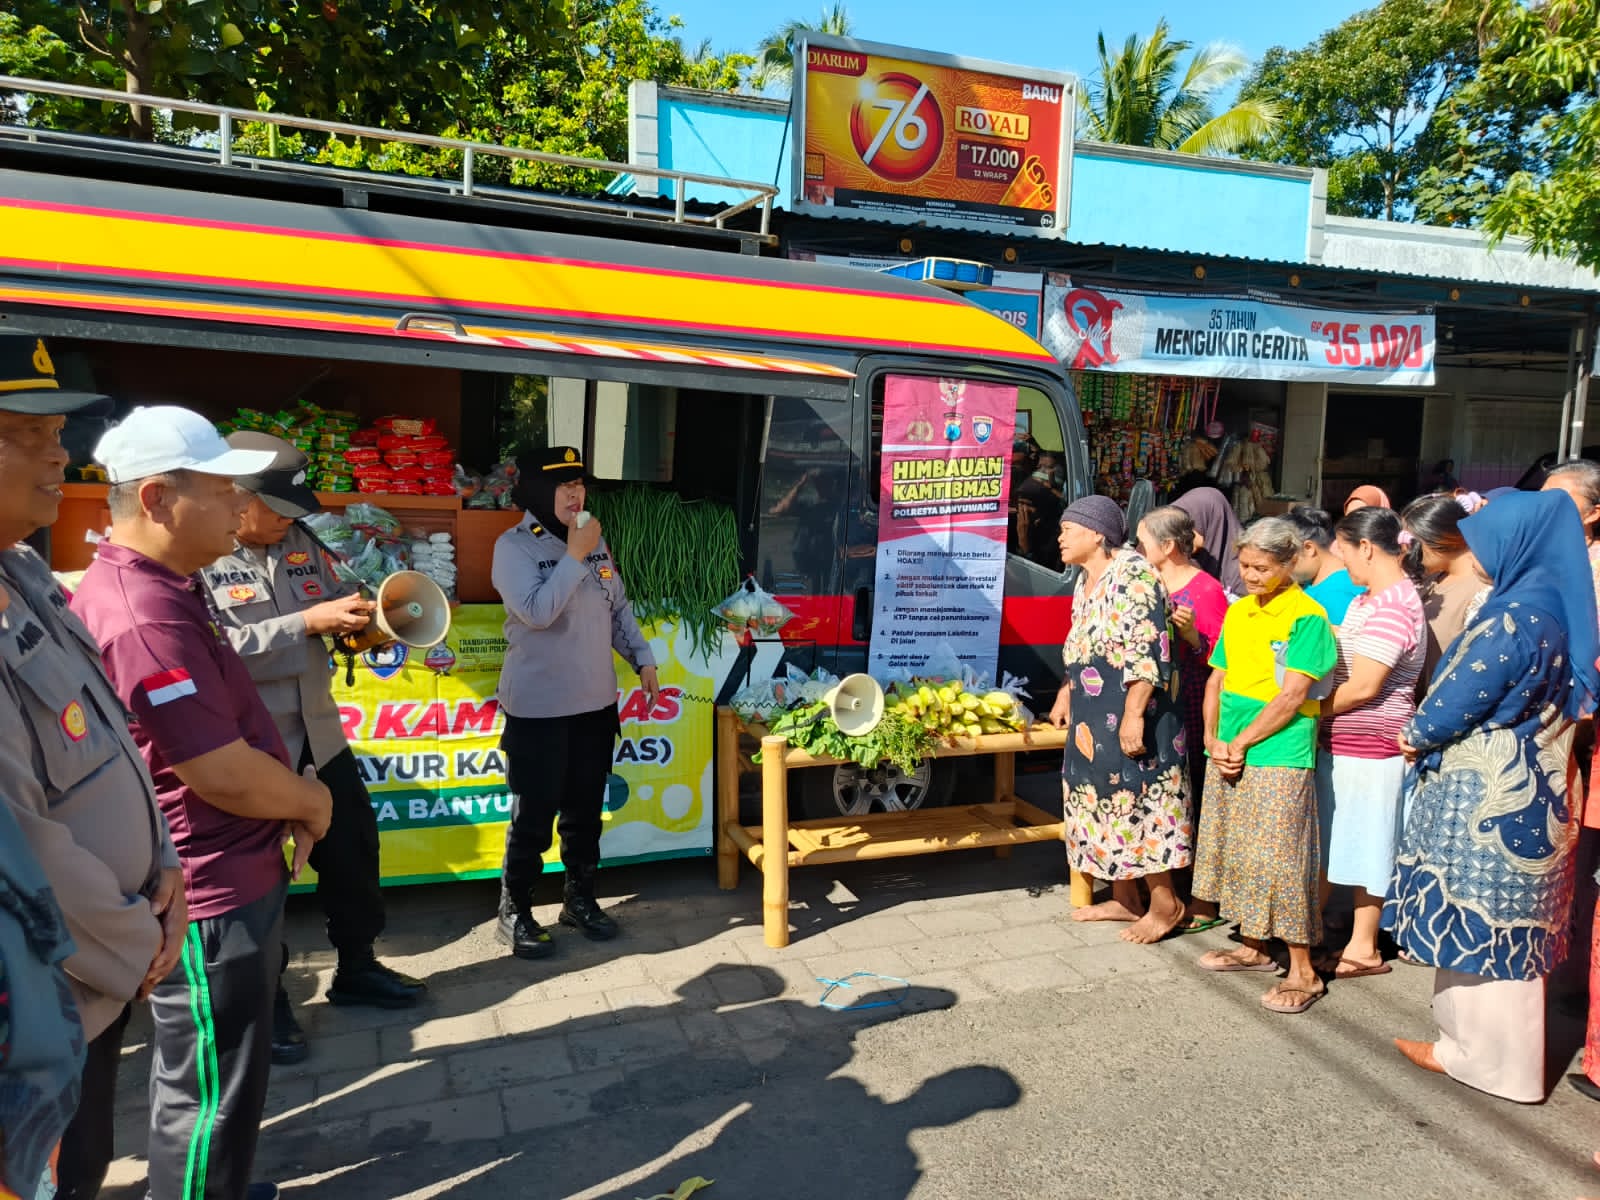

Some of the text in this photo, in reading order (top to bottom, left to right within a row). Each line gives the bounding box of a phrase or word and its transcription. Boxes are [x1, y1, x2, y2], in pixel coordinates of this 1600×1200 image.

[807, 50, 860, 70] DJARUM
[1022, 83, 1060, 104] BARU
[862, 84, 929, 166] 76
[959, 109, 1026, 137] ROYAL
[971, 145, 1019, 169] 17.000
[974, 168, 1009, 182] 12 WRAPS
[1208, 308, 1257, 331] 35 TAHUN
[1155, 327, 1309, 361] MENGUKIR CERITA
[1322, 321, 1425, 368] 35.000
[893, 456, 1003, 481] HIMBAUAN
[893, 479, 1001, 503] KAMTIBMAS
[894, 502, 998, 518] POLRESTA BANYUWANGI
[374, 700, 499, 739] KAM
[616, 738, 672, 764] AS)
